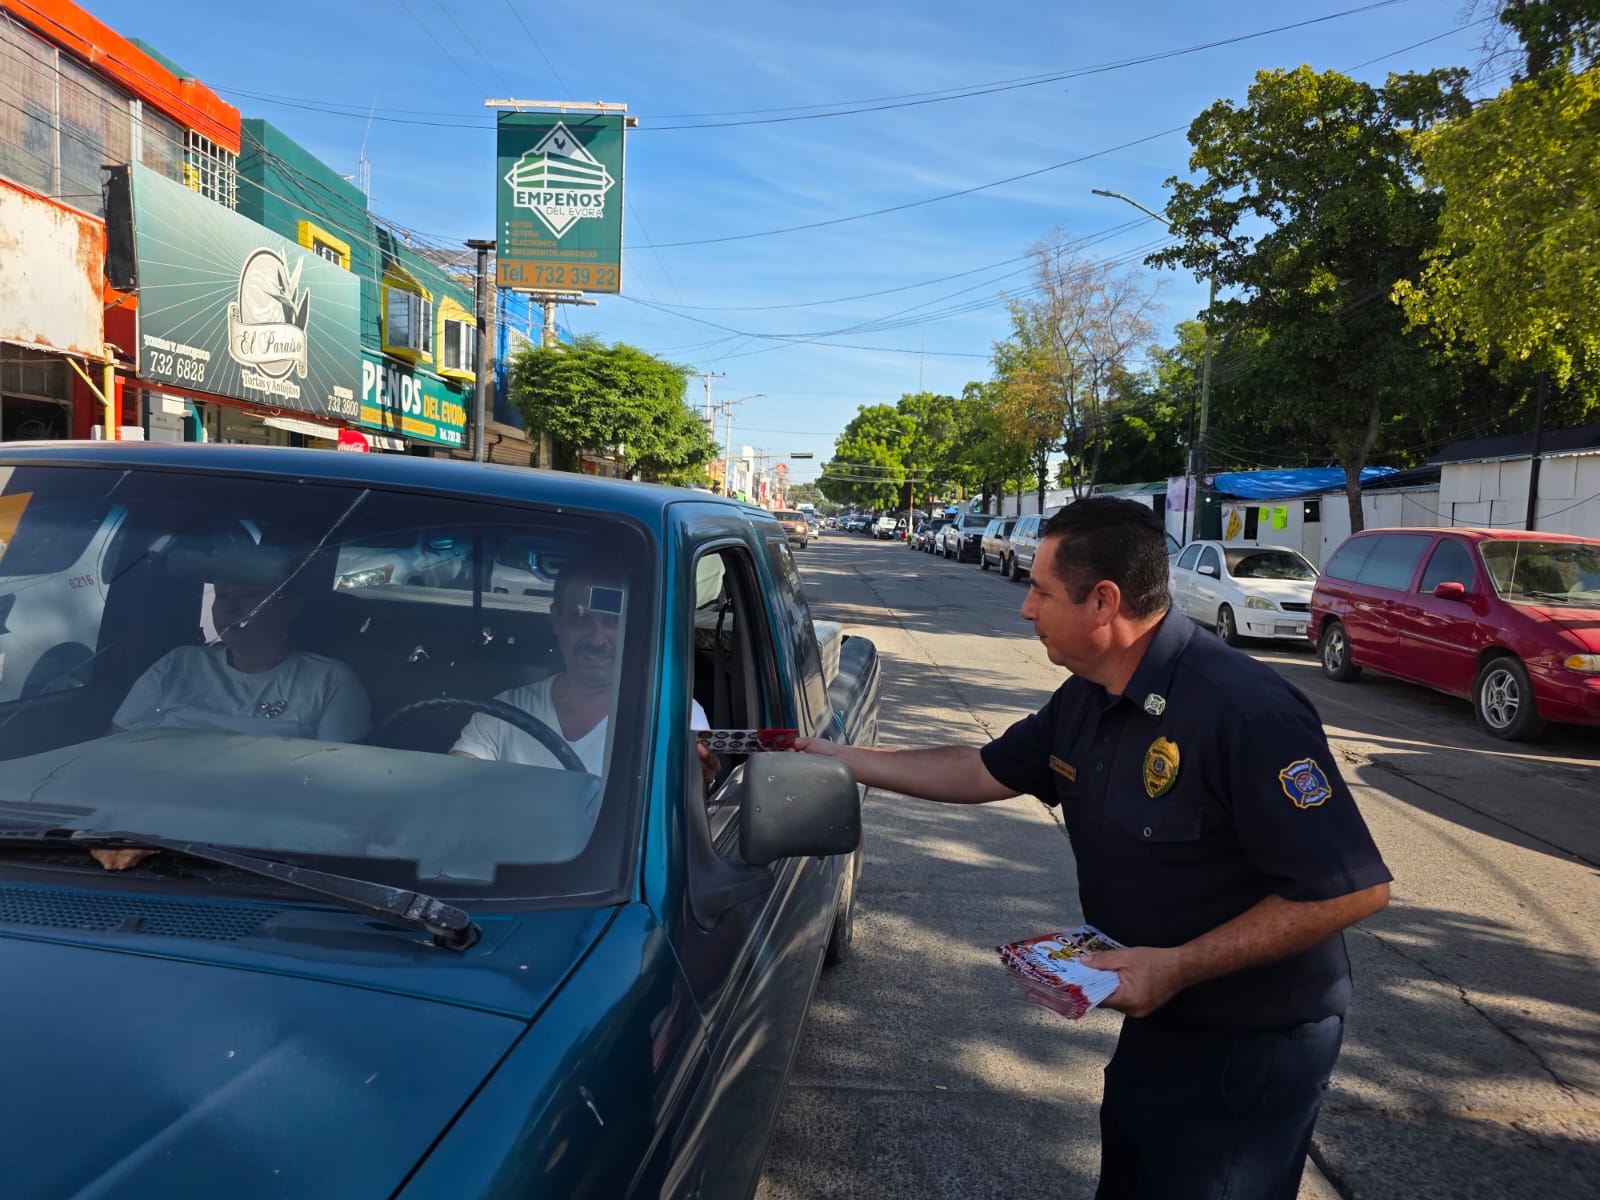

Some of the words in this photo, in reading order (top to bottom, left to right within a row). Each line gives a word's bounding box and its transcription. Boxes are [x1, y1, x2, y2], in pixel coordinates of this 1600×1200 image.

[516, 190, 602, 207] EMPEÑOS
[546, 206, 565, 216] DEL
[500, 263, 528, 282] Tel.
[534, 265, 565, 284] 732
[570, 267, 590, 285] 39
[596, 268, 616, 286] 22
[241, 330, 256, 355] El
[150, 350, 173, 376] 732
[176, 358, 205, 383] 6828
[243, 371, 266, 389] Tortas
[362, 359, 421, 415] PEÑOS
[327, 394, 341, 413] 732
[341, 398, 359, 417] 3800
[423, 394, 440, 421] DEL
[69, 574, 95, 590] 6216
